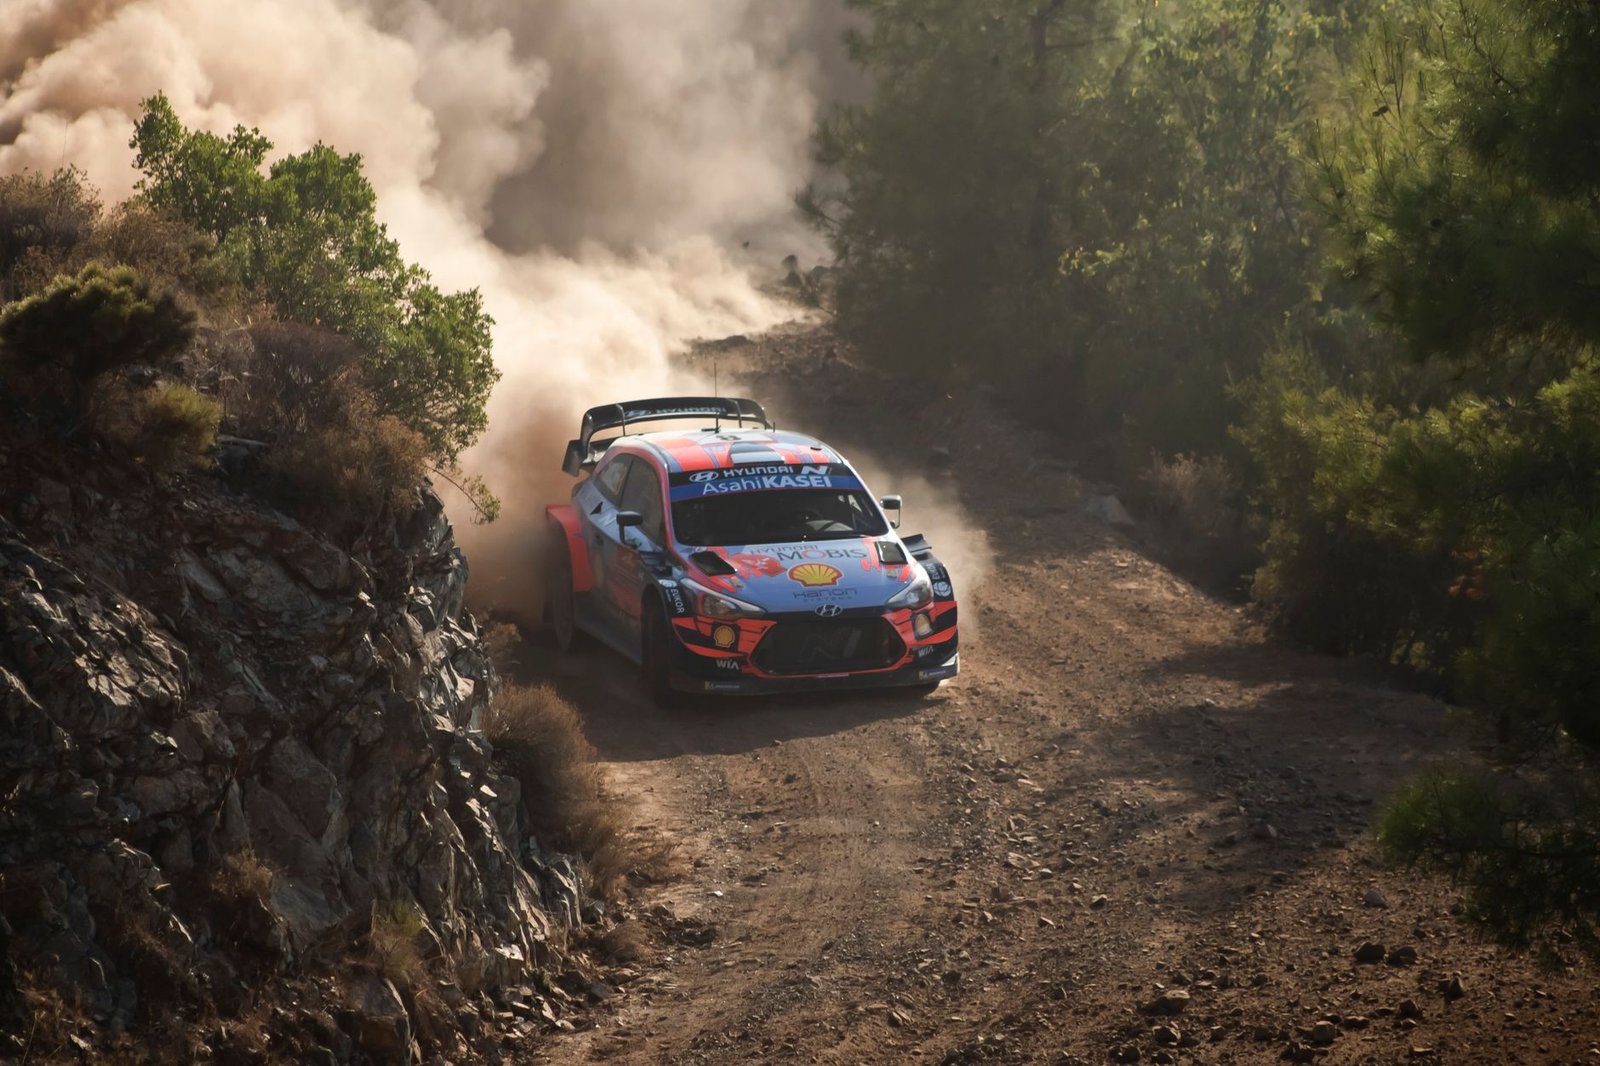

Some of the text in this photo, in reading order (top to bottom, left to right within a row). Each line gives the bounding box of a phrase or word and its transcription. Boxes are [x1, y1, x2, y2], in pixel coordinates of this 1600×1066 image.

[723, 466, 794, 478] HYUNDAI
[750, 544, 818, 555] HYUNDAI
[776, 548, 867, 561] MOBIS
[671, 588, 685, 614] EUKOR
[716, 659, 740, 670] WIA
